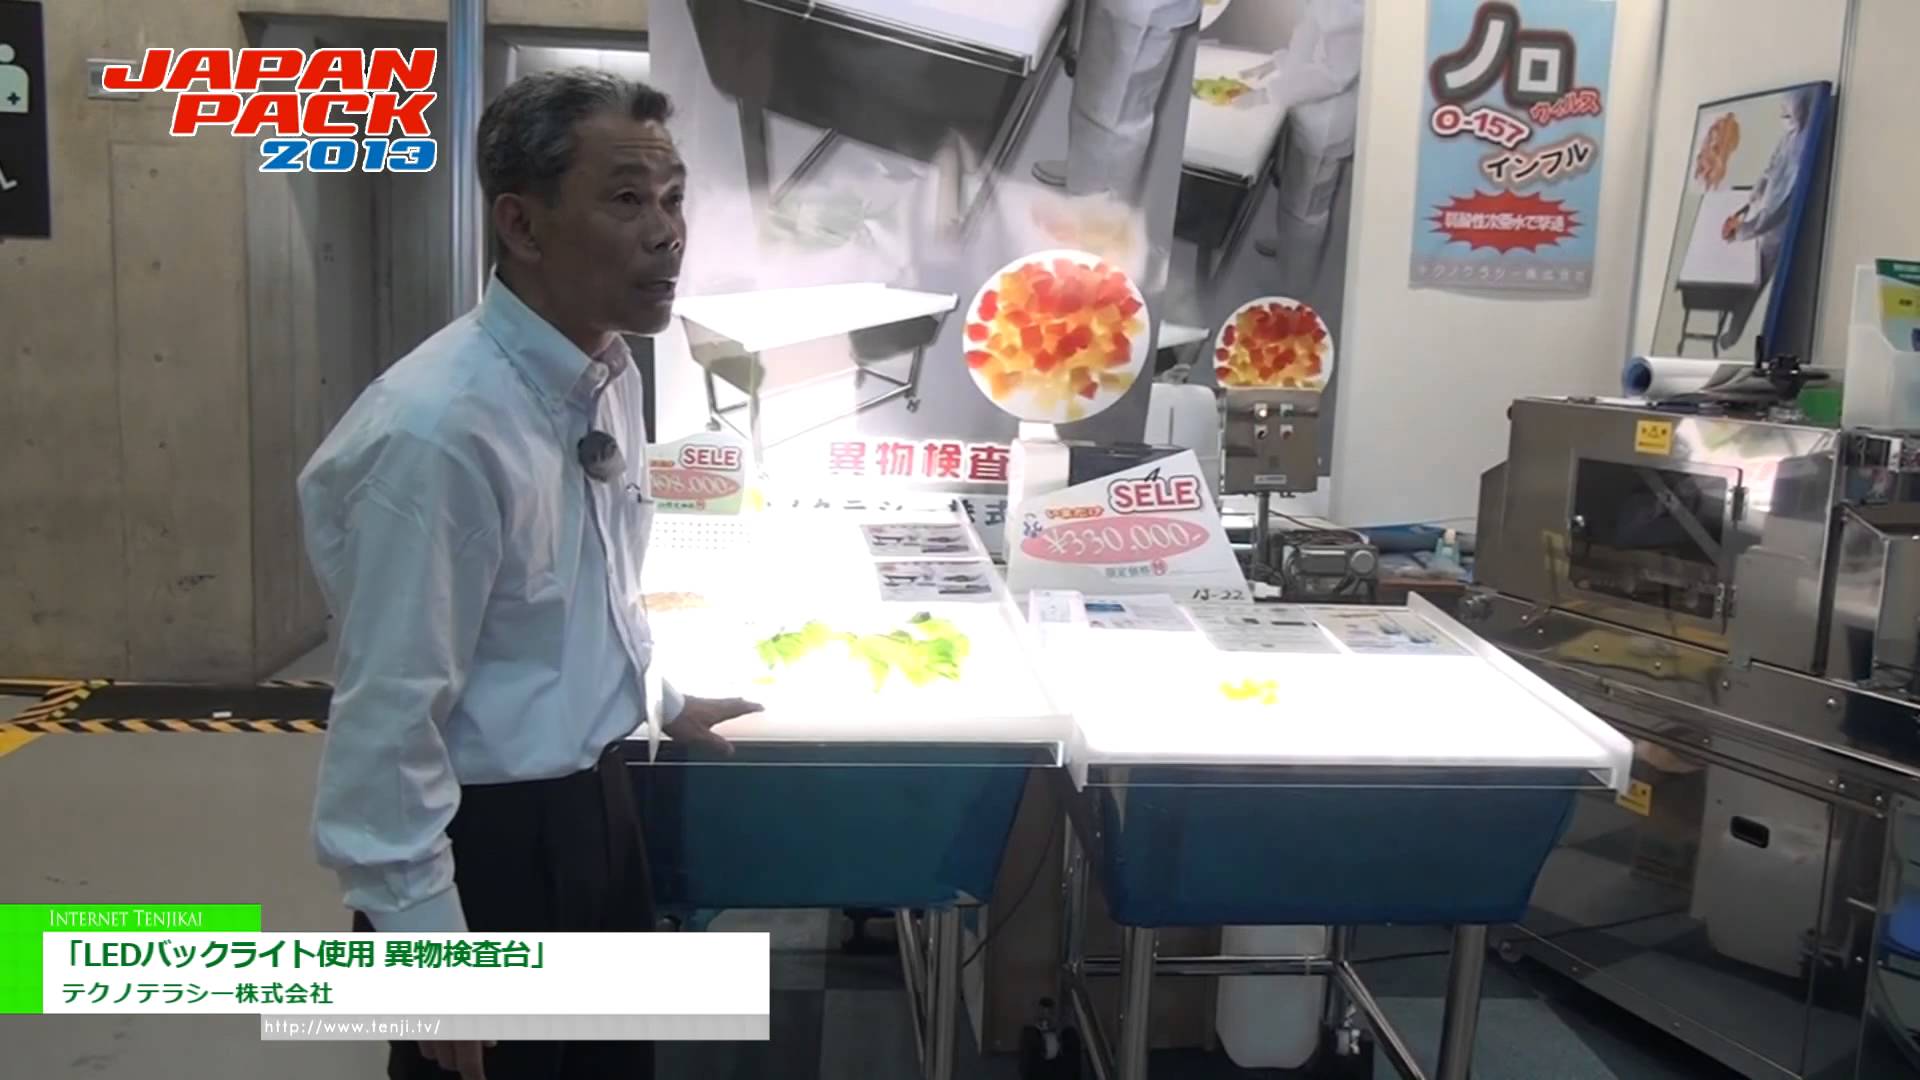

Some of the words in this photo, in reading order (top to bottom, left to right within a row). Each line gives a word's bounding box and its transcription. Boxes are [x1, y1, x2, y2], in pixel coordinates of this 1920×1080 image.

[1440, 13, 1566, 98] ノロ
[1434, 106, 1527, 147] O-157
[1487, 142, 1589, 179] インフル
[682, 447, 738, 467] SELE
[1113, 480, 1195, 508] SELE
